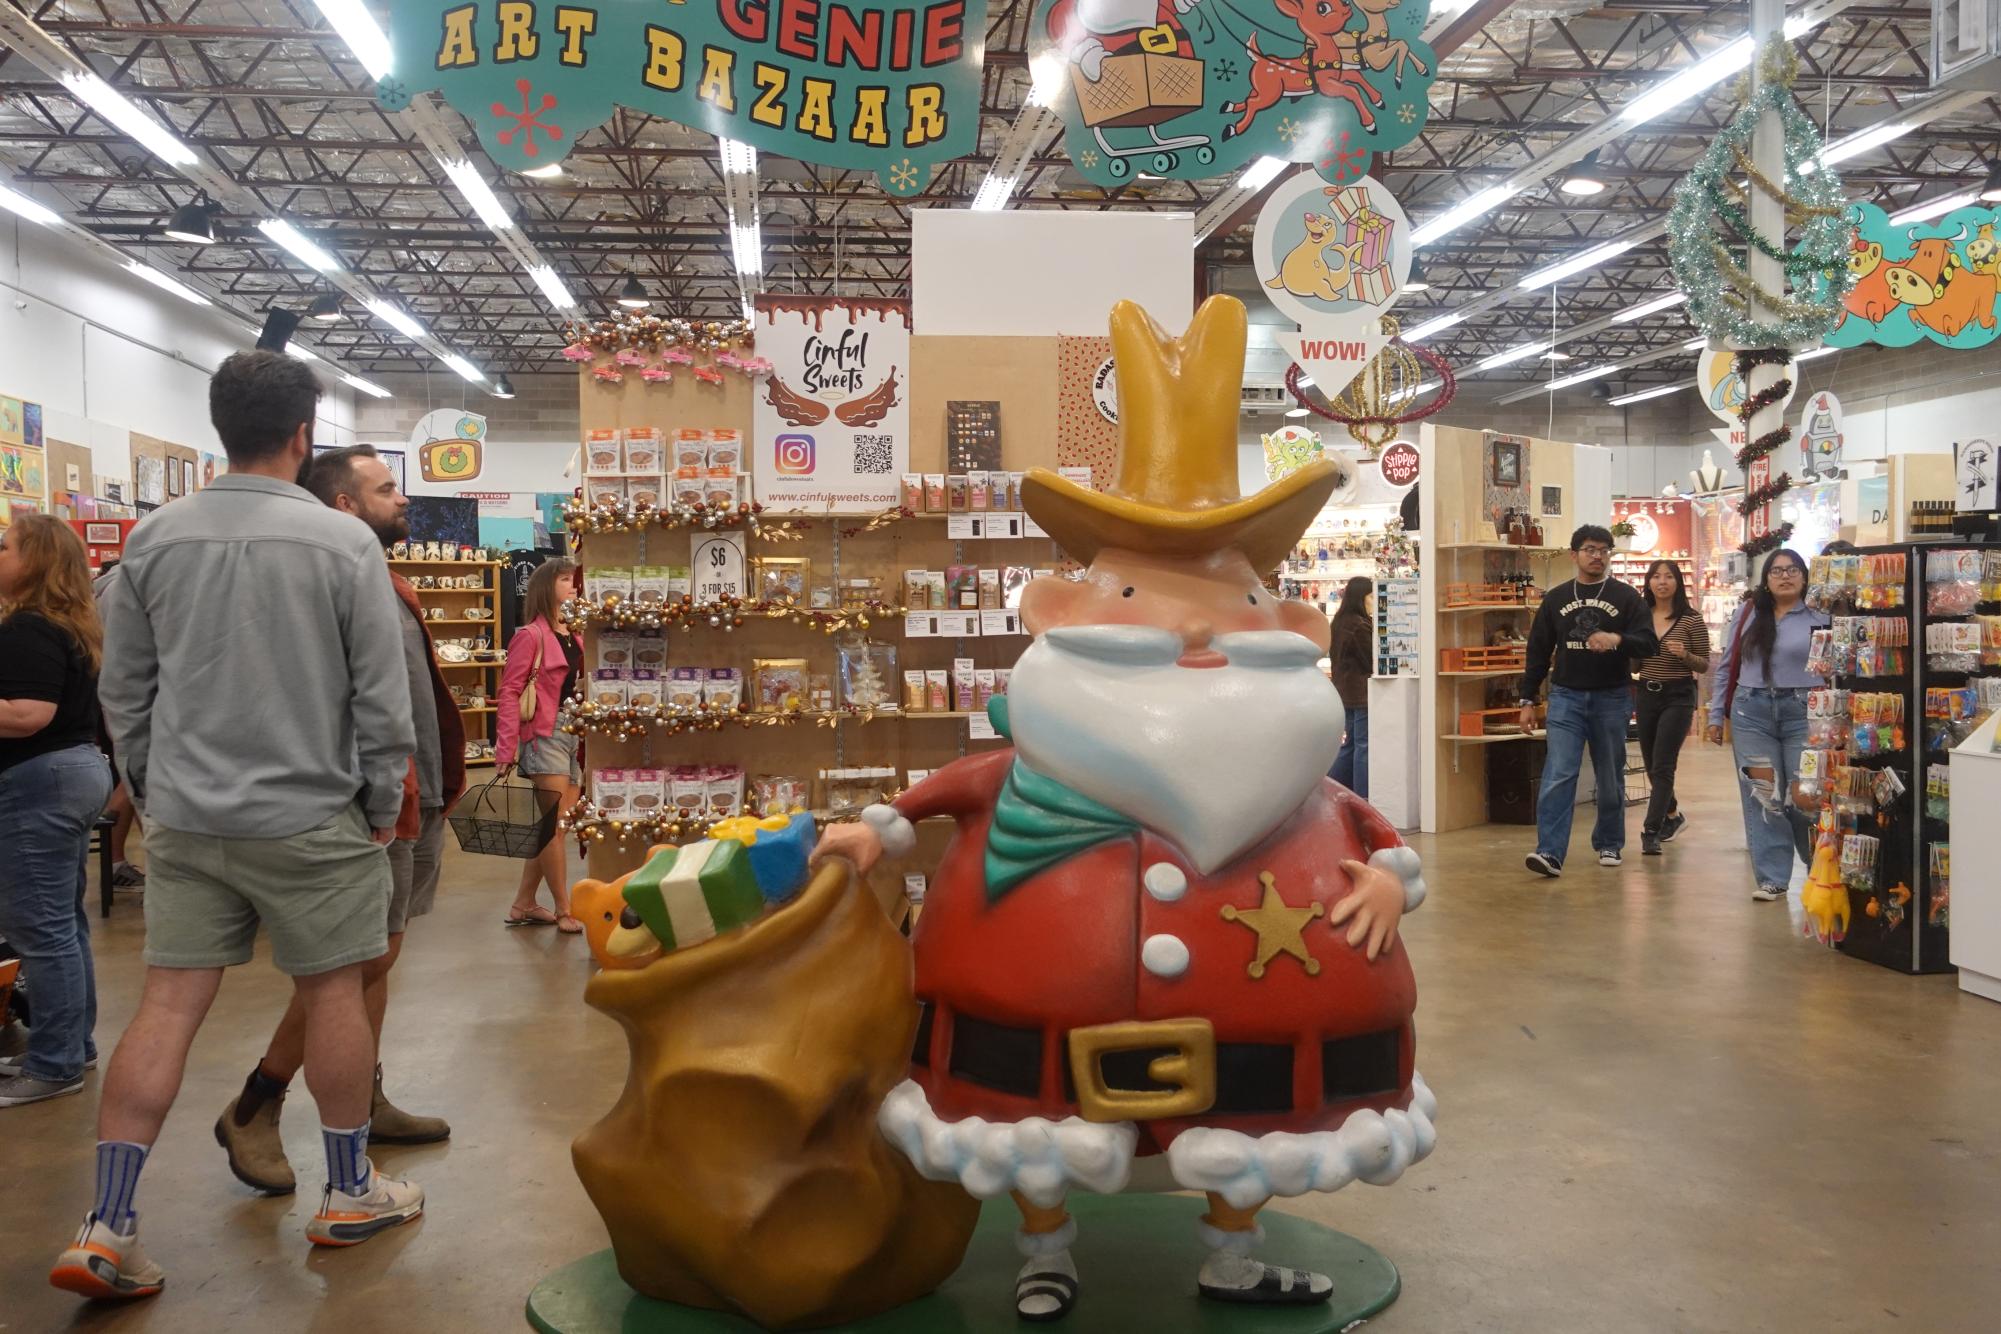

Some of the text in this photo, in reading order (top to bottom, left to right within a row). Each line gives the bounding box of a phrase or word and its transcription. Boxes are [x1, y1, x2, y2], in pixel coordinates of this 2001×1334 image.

[717, 0, 965, 71] GENIE
[437, 1, 946, 148] ART BAZAAR
[803, 328, 869, 370] Cinful
[1300, 339, 1366, 362] WOW!
[802, 363, 864, 394] Sweets
[1099, 400, 1118, 421] Cook
[1752, 463, 1767, 472] FIRE
[768, 492, 897, 503] www.cinfulsweets.com
[710, 546, 726, 568] $6
[702, 583, 707, 594] 3
[708, 583, 722, 594] FOR
[1559, 598, 1619, 617] MOST WANTED
[1566, 641, 1584, 650] WELL
